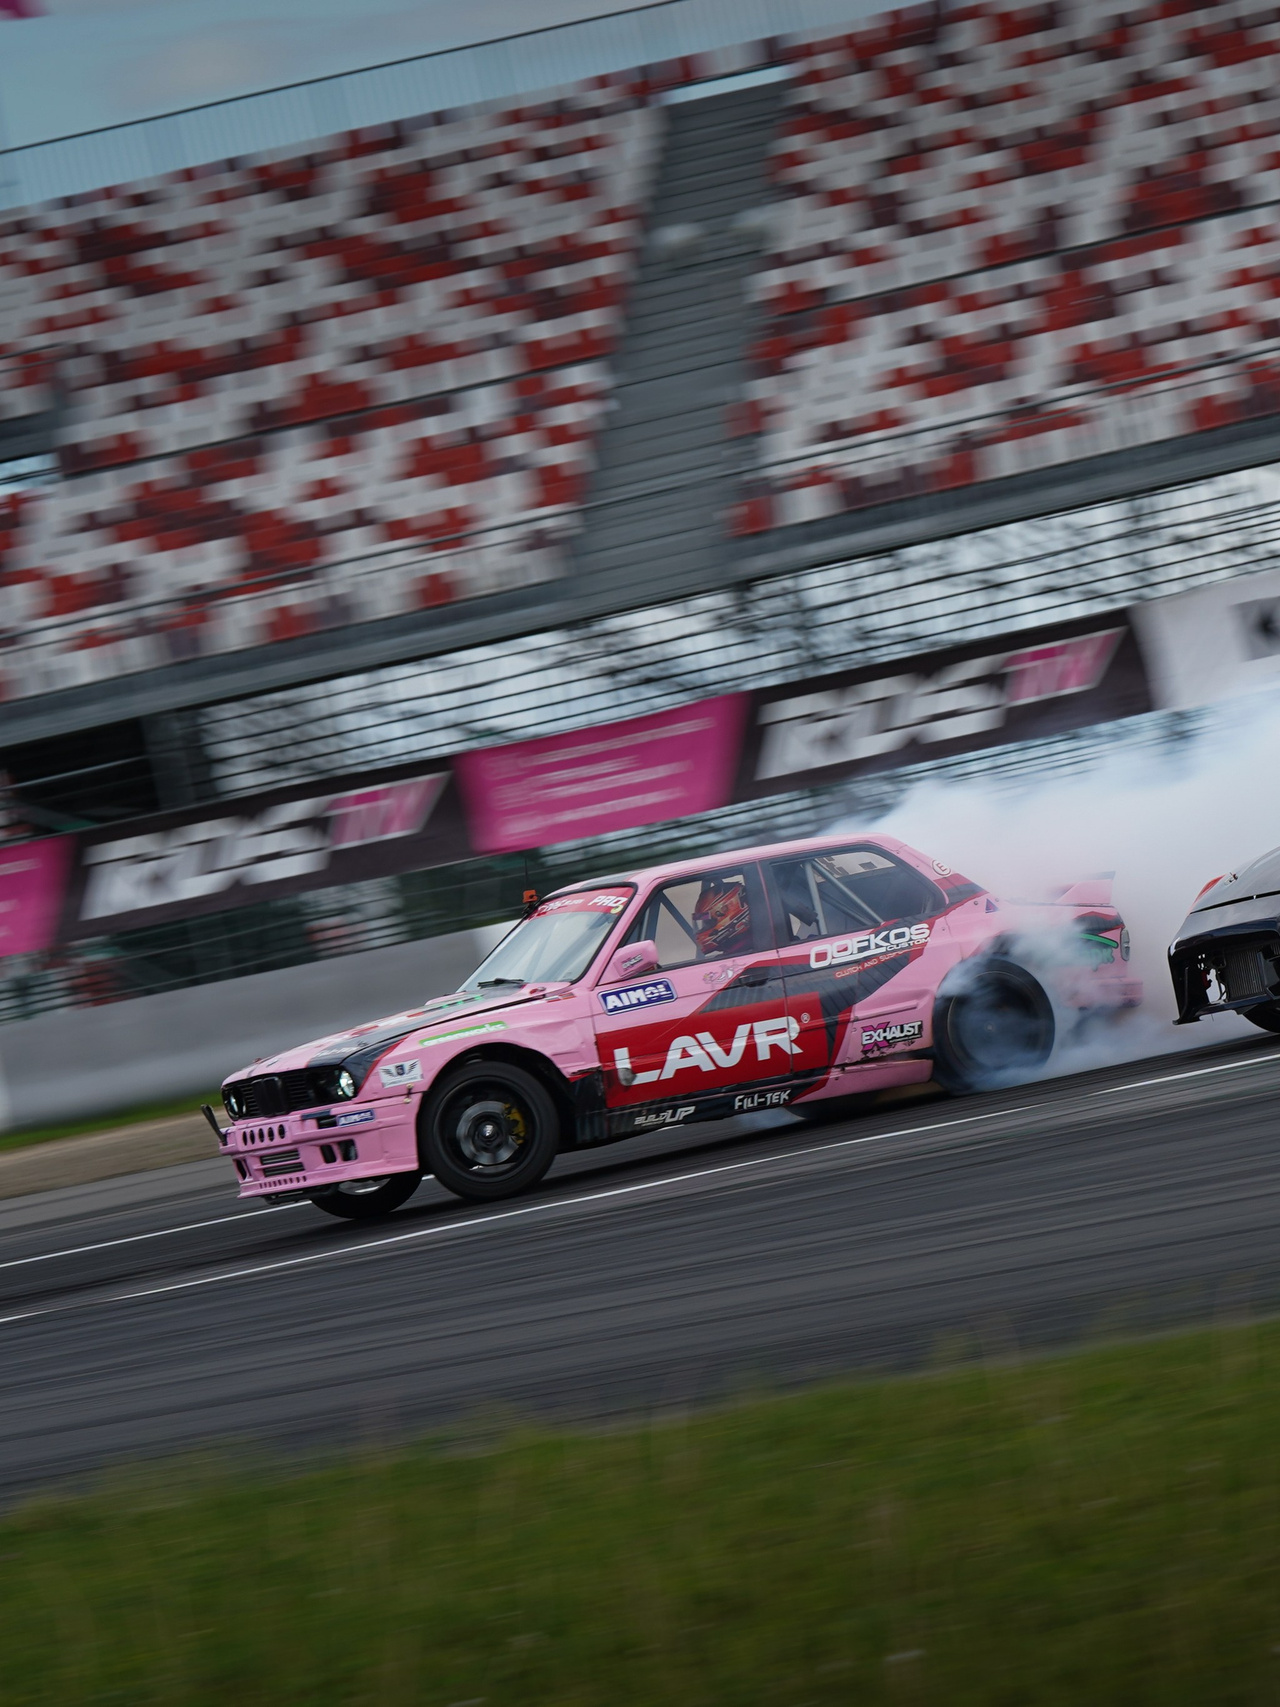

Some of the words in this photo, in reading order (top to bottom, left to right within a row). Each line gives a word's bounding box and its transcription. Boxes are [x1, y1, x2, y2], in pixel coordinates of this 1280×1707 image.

[886, 938, 931, 951] CUSTOM
[835, 966, 862, 978] CLUTCH
[864, 958, 879, 969] AND
[605, 984, 672, 1010] AIMOL
[861, 1021, 922, 1047] EXHAUST
[613, 1016, 804, 1087] LAVR
